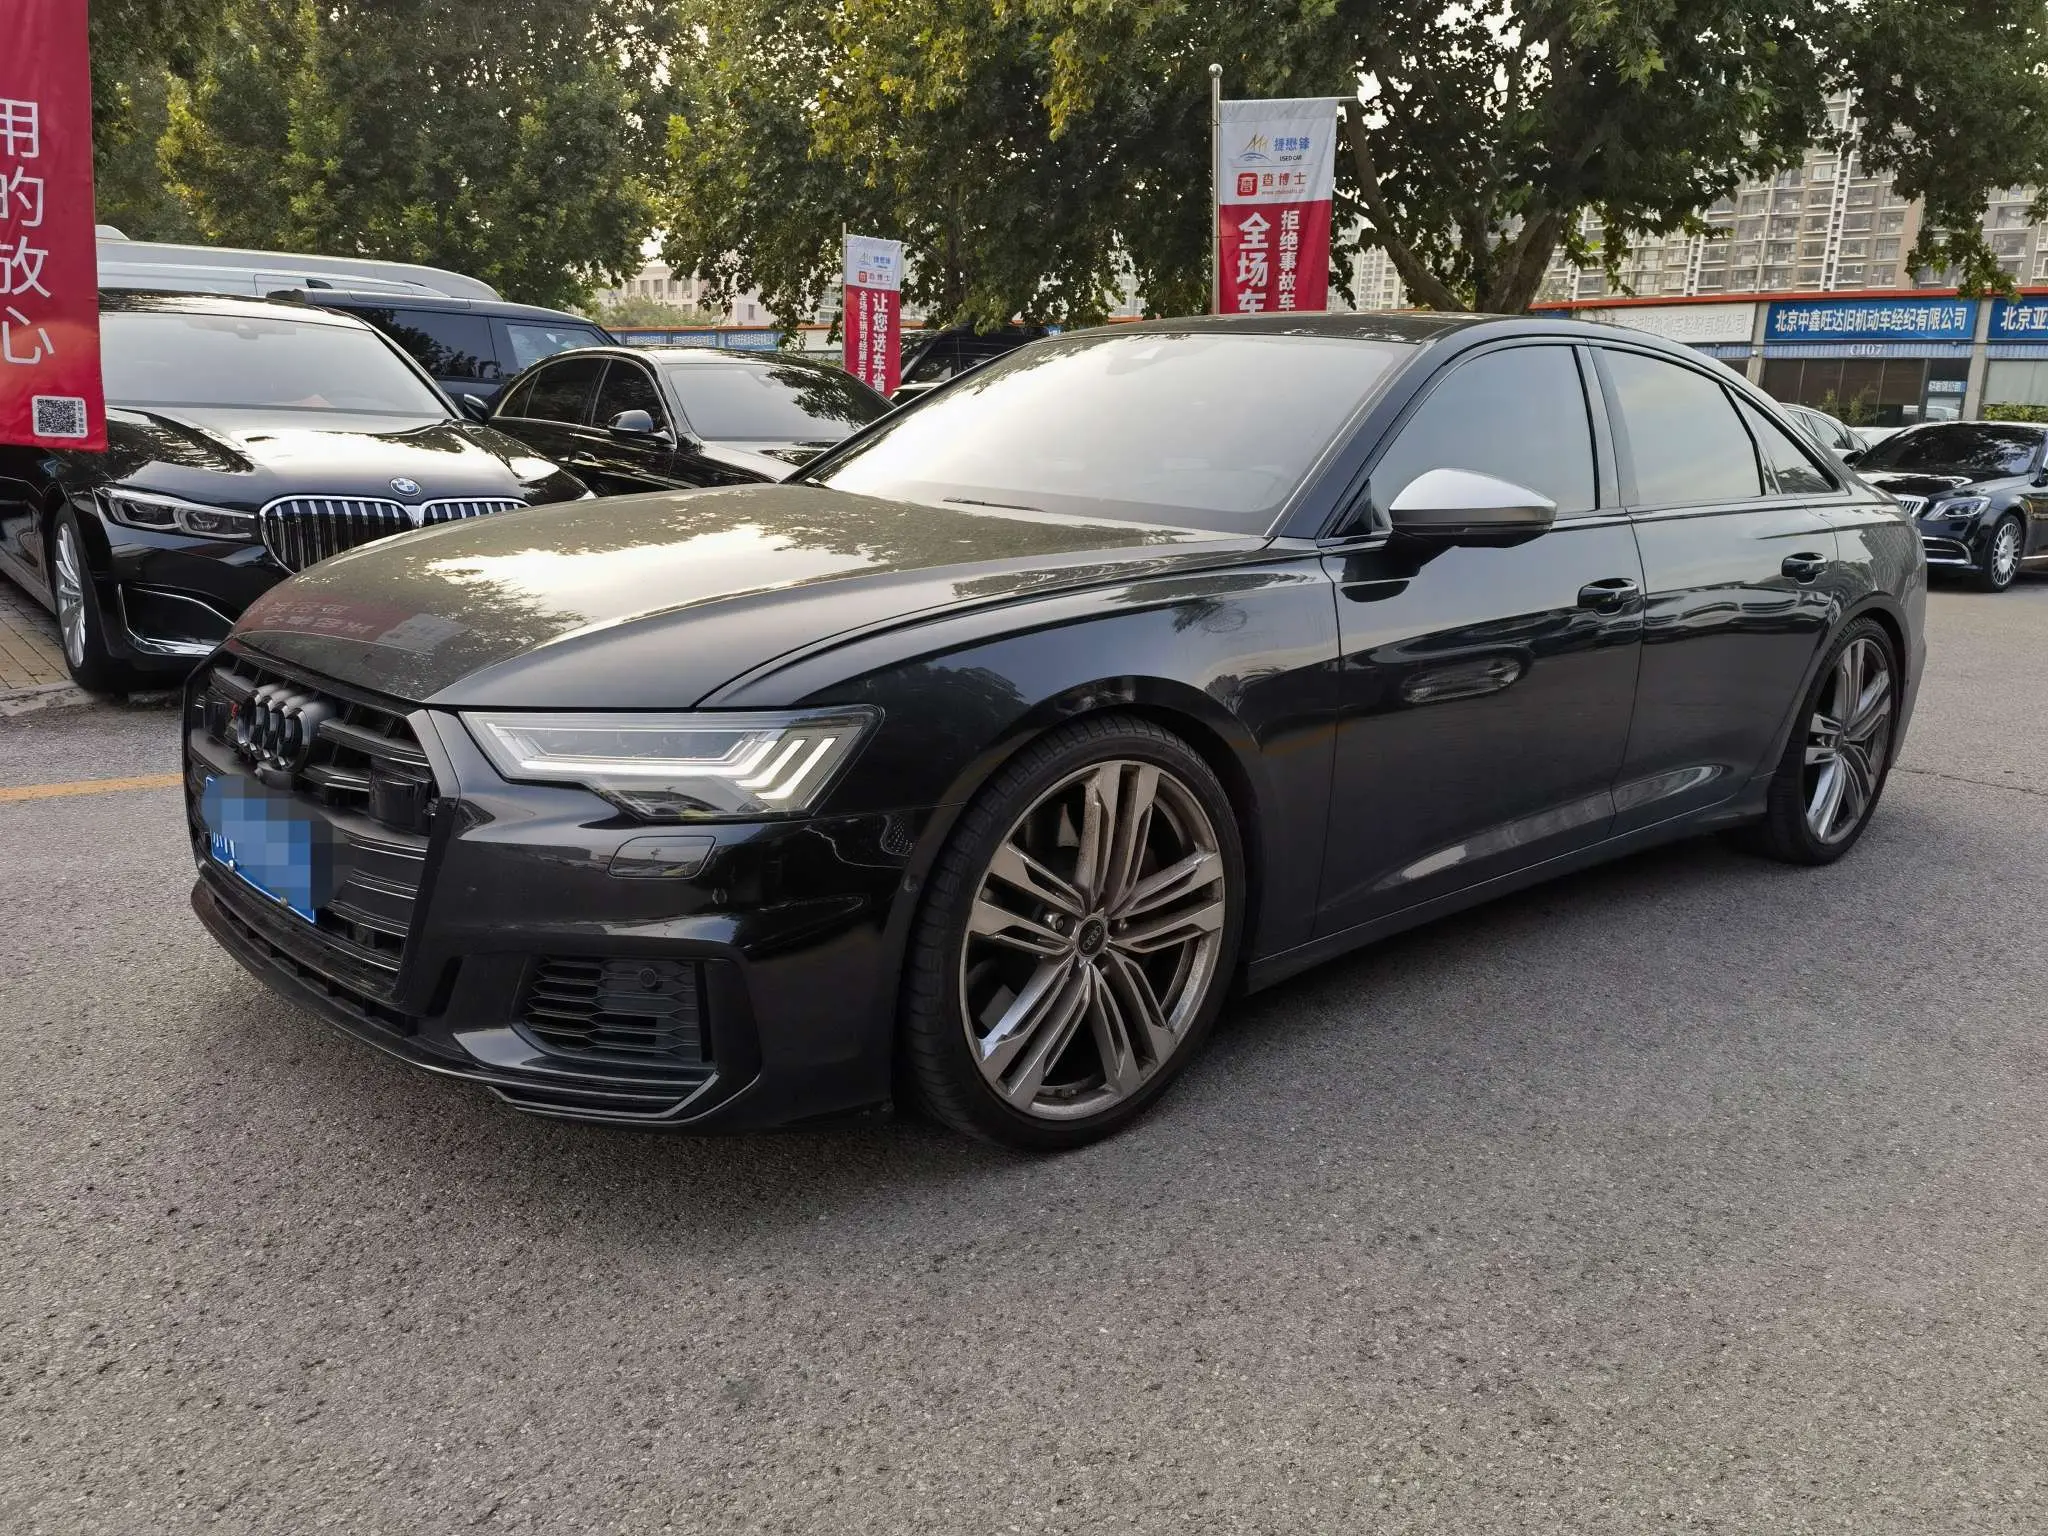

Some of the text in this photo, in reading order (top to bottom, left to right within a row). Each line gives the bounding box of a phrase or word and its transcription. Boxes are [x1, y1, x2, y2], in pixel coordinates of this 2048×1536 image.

[1262, 171, 1307, 187] 查博士
[0, 99, 54, 364] 用的放心
[1236, 211, 1271, 315] 全场车
[1278, 209, 1300, 312] 拒绝事故车
[872, 292, 889, 393] 让您选车省
[1775, 306, 1968, 332] 北京中鑫旺达旧机动车经纪有限公司
